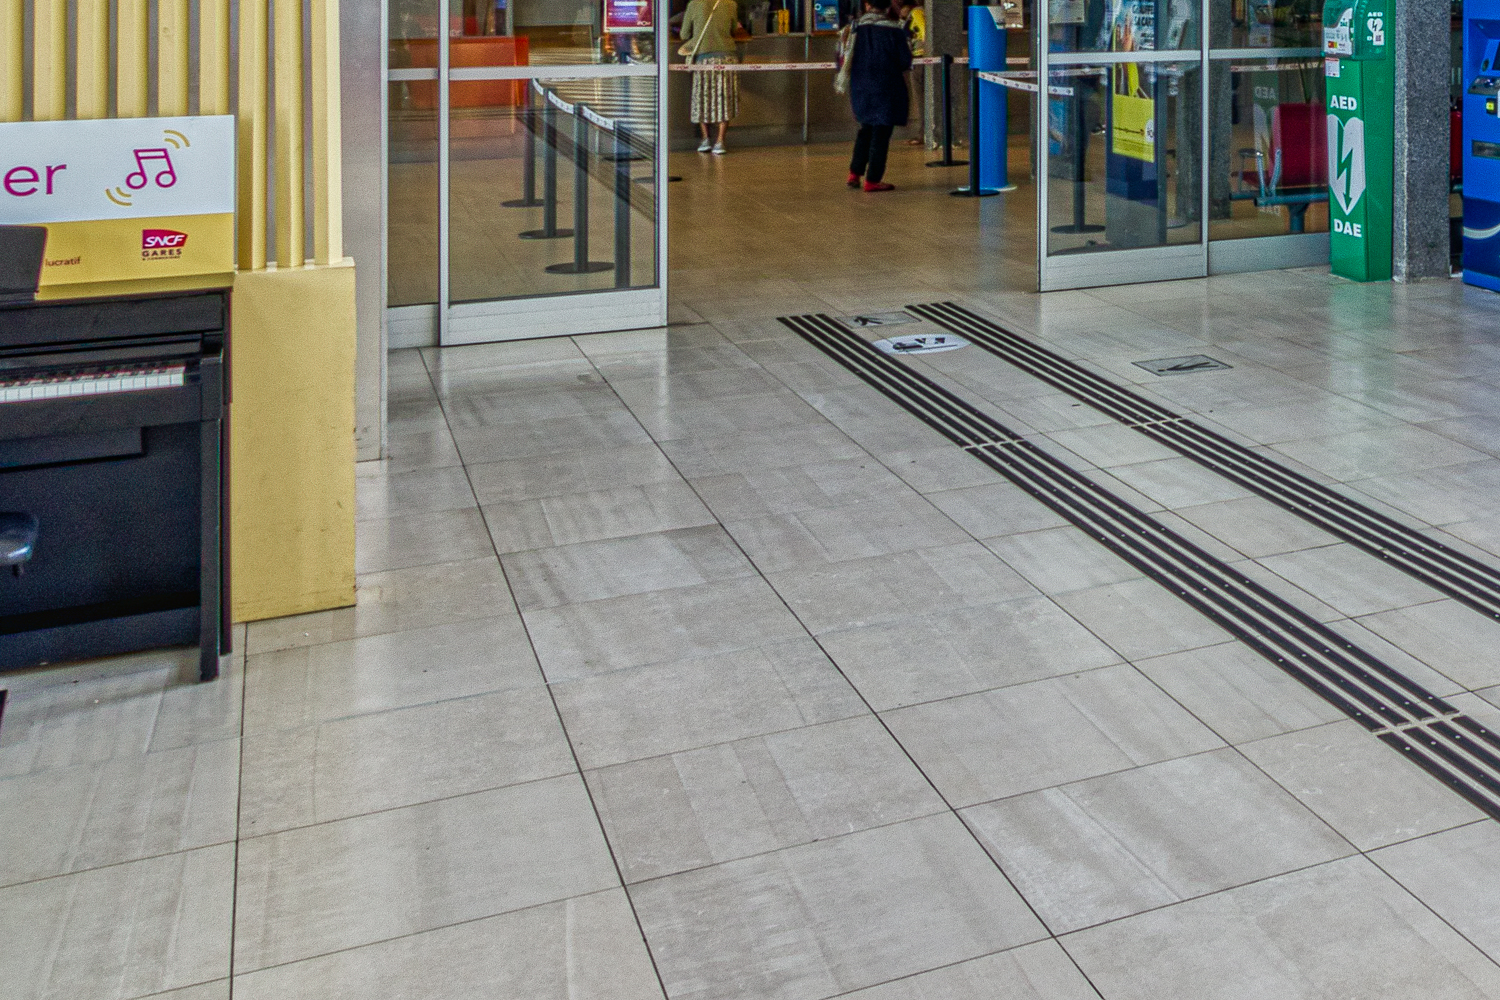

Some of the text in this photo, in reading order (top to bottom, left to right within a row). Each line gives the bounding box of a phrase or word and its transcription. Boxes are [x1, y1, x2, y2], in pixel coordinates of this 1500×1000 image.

[1330, 95, 1357, 110] AED
[1334, 218, 1362, 238] DAE
[144, 234, 186, 247] SNCF
[142, 249, 182, 257] GARES
